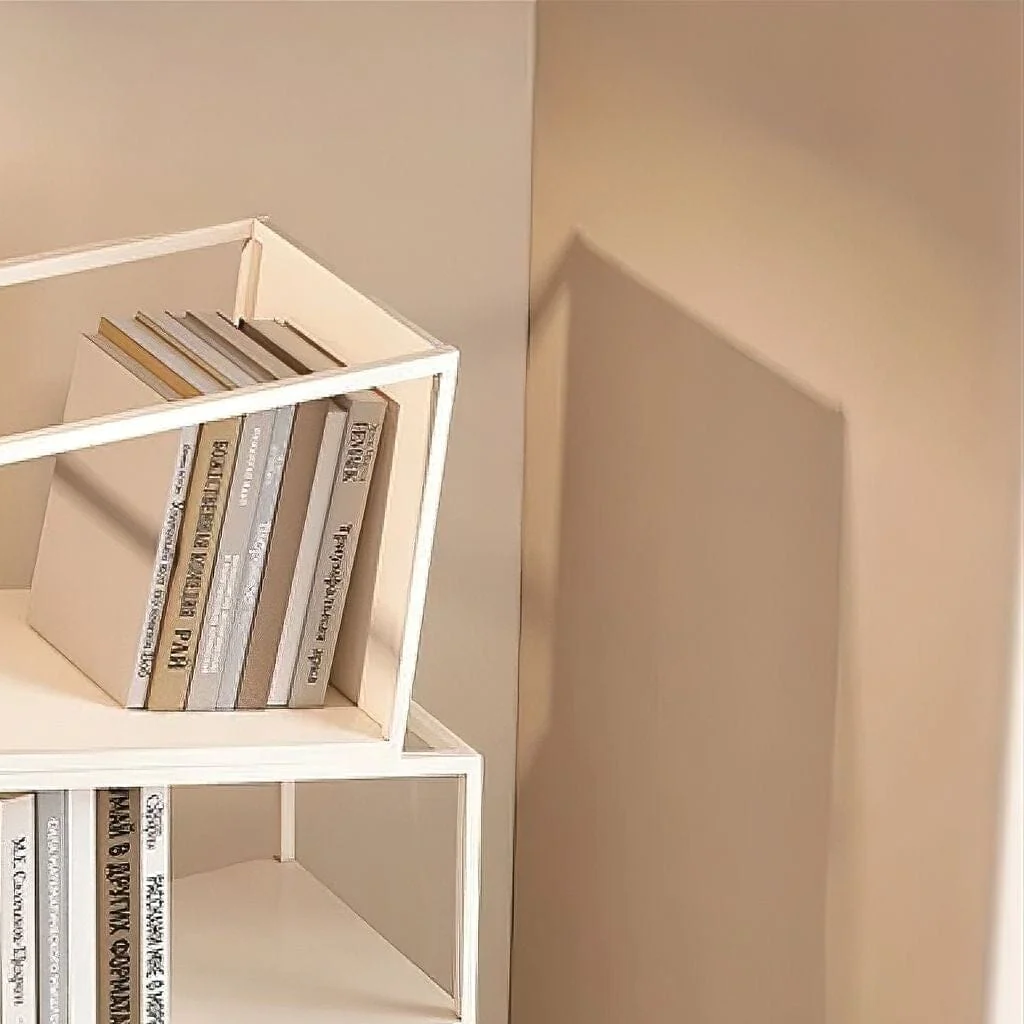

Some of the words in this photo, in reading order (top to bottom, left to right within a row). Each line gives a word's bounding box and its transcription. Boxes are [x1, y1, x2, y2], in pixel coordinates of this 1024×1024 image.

[179, 552, 207, 618] КОМЕДИЯ
[167, 629, 193, 669] РАЙ
[108, 787, 136, 839] МАЙ
[104, 862, 130, 935] ДРУГИХ
